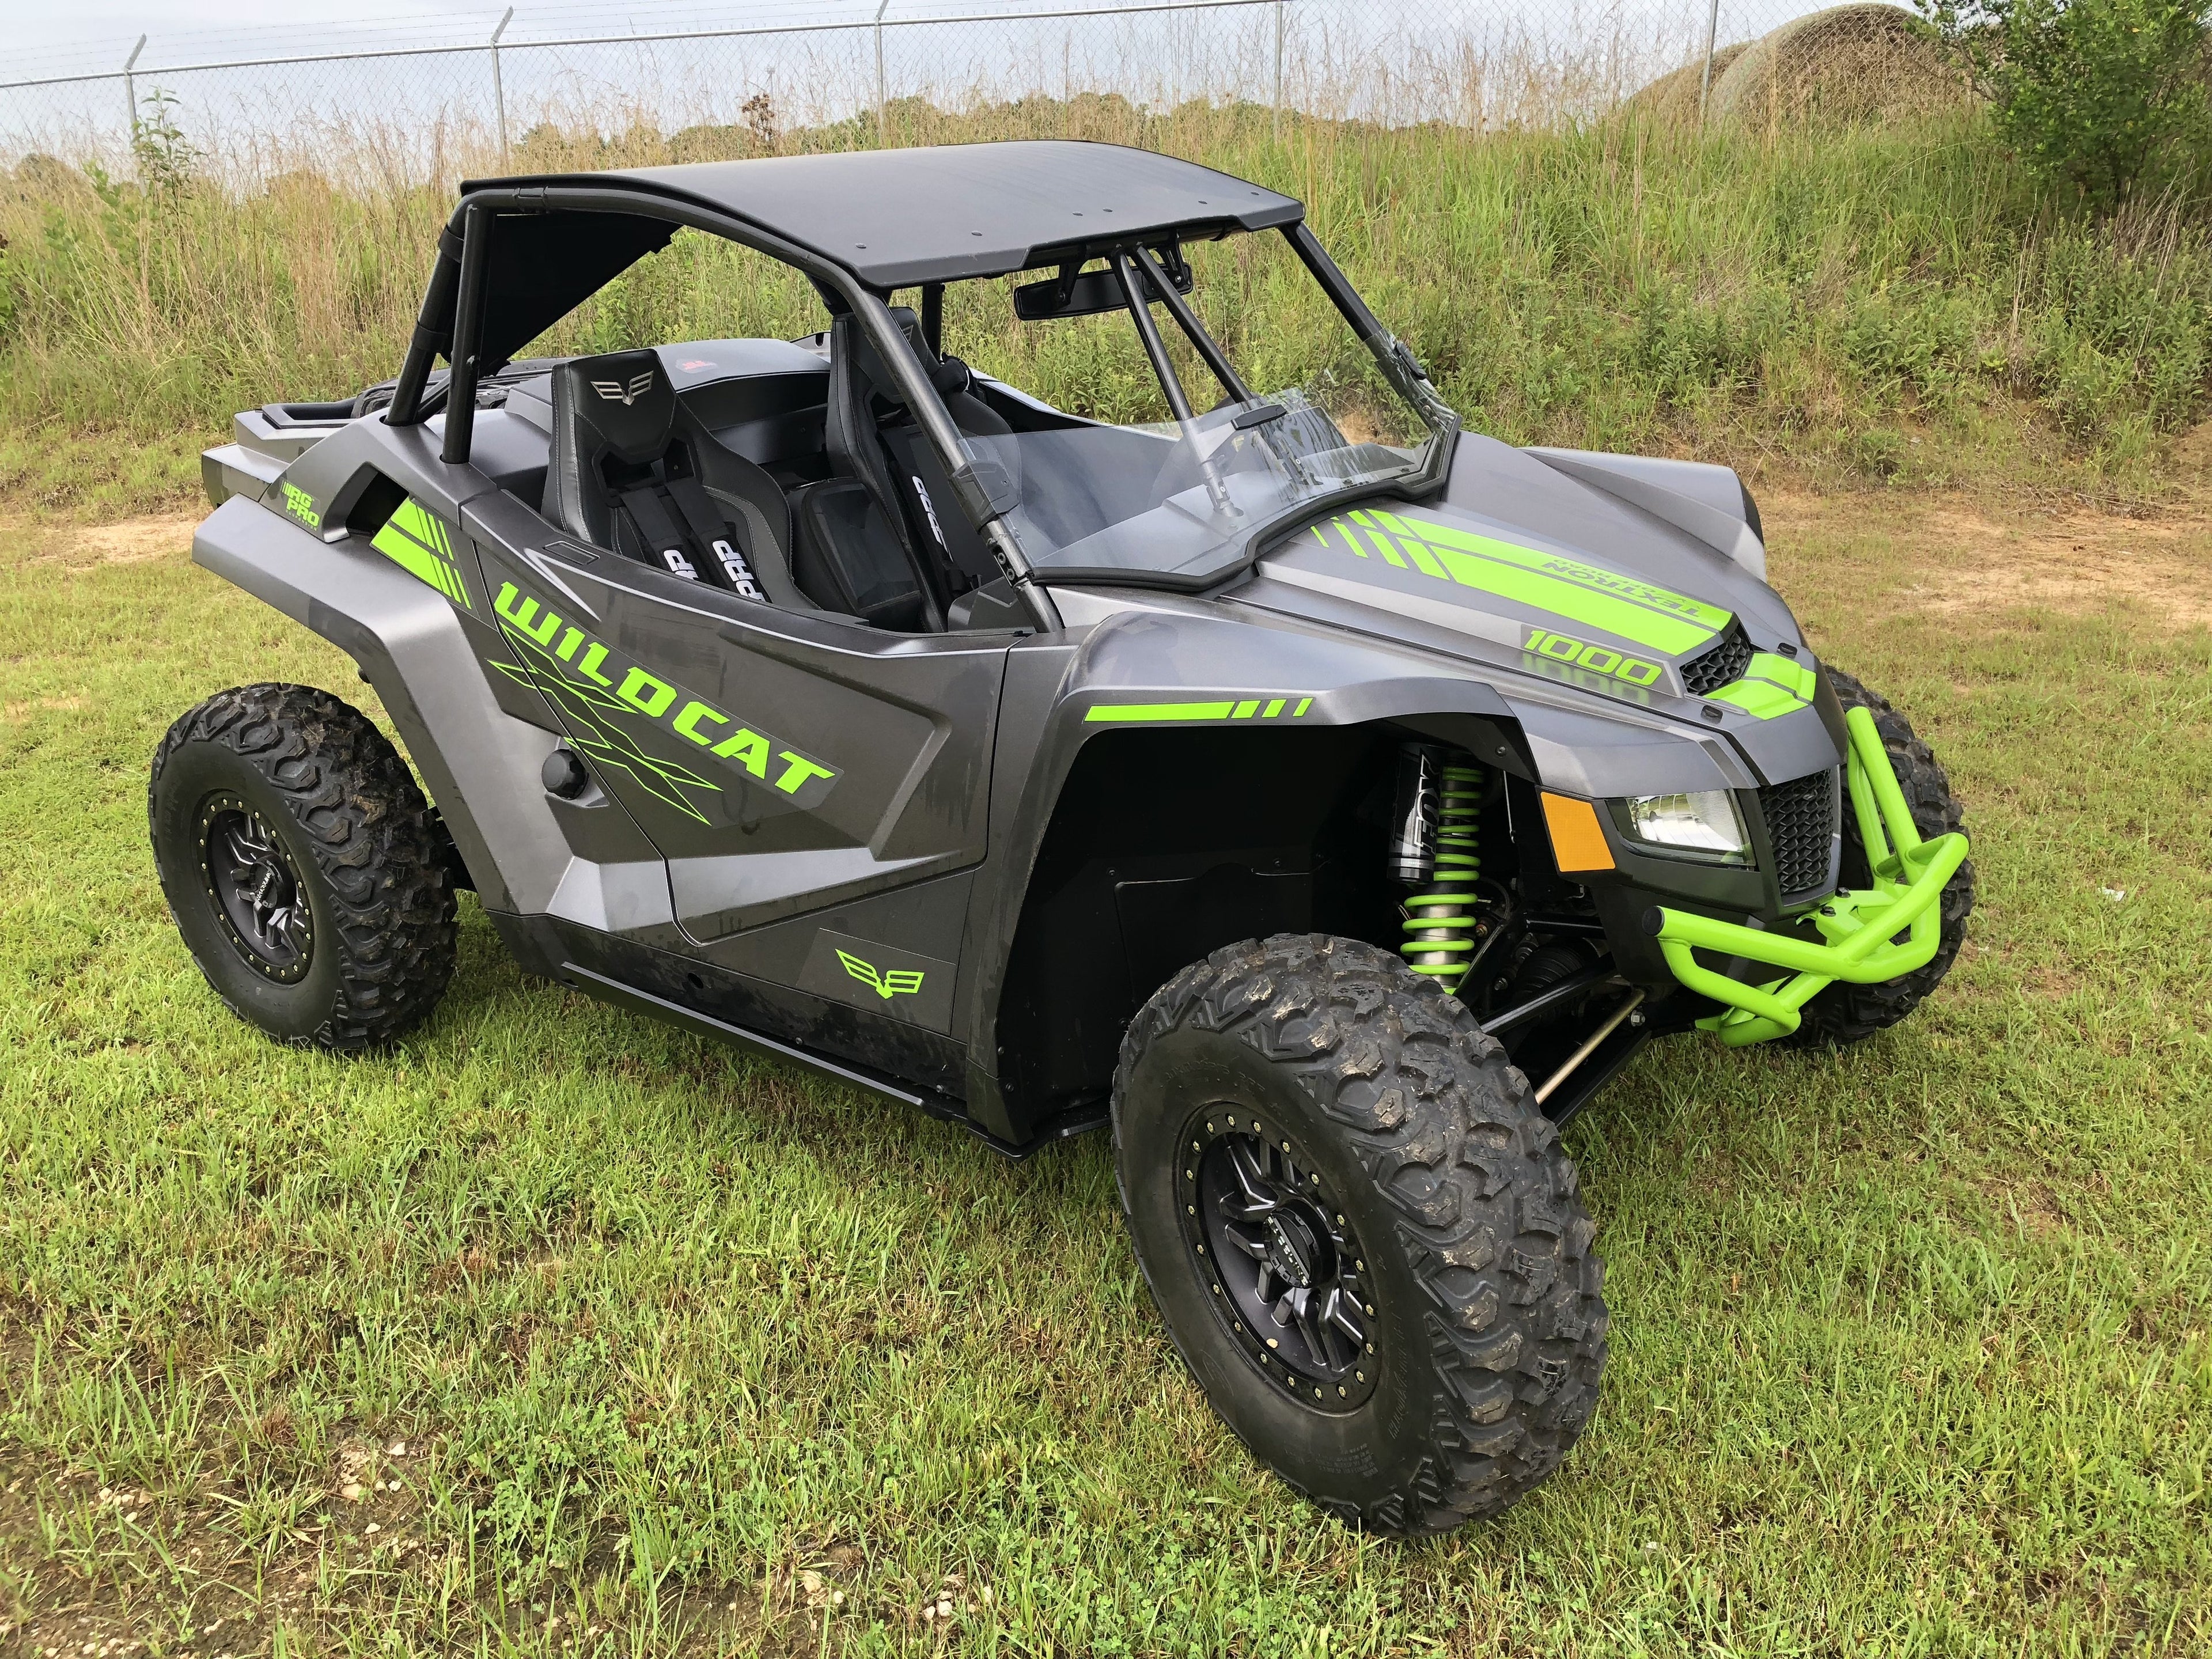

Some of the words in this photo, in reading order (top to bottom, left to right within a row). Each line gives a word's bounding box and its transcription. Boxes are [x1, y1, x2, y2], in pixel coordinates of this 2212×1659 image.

[286, 499, 319, 527] PRO
[713, 540, 766, 601] PRP
[1541, 562, 1699, 617] TEXTRON
[1524, 630, 1662, 686] 1000
[494, 582, 835, 794] WILDCAT
[1414, 753, 1440, 855] FOX
